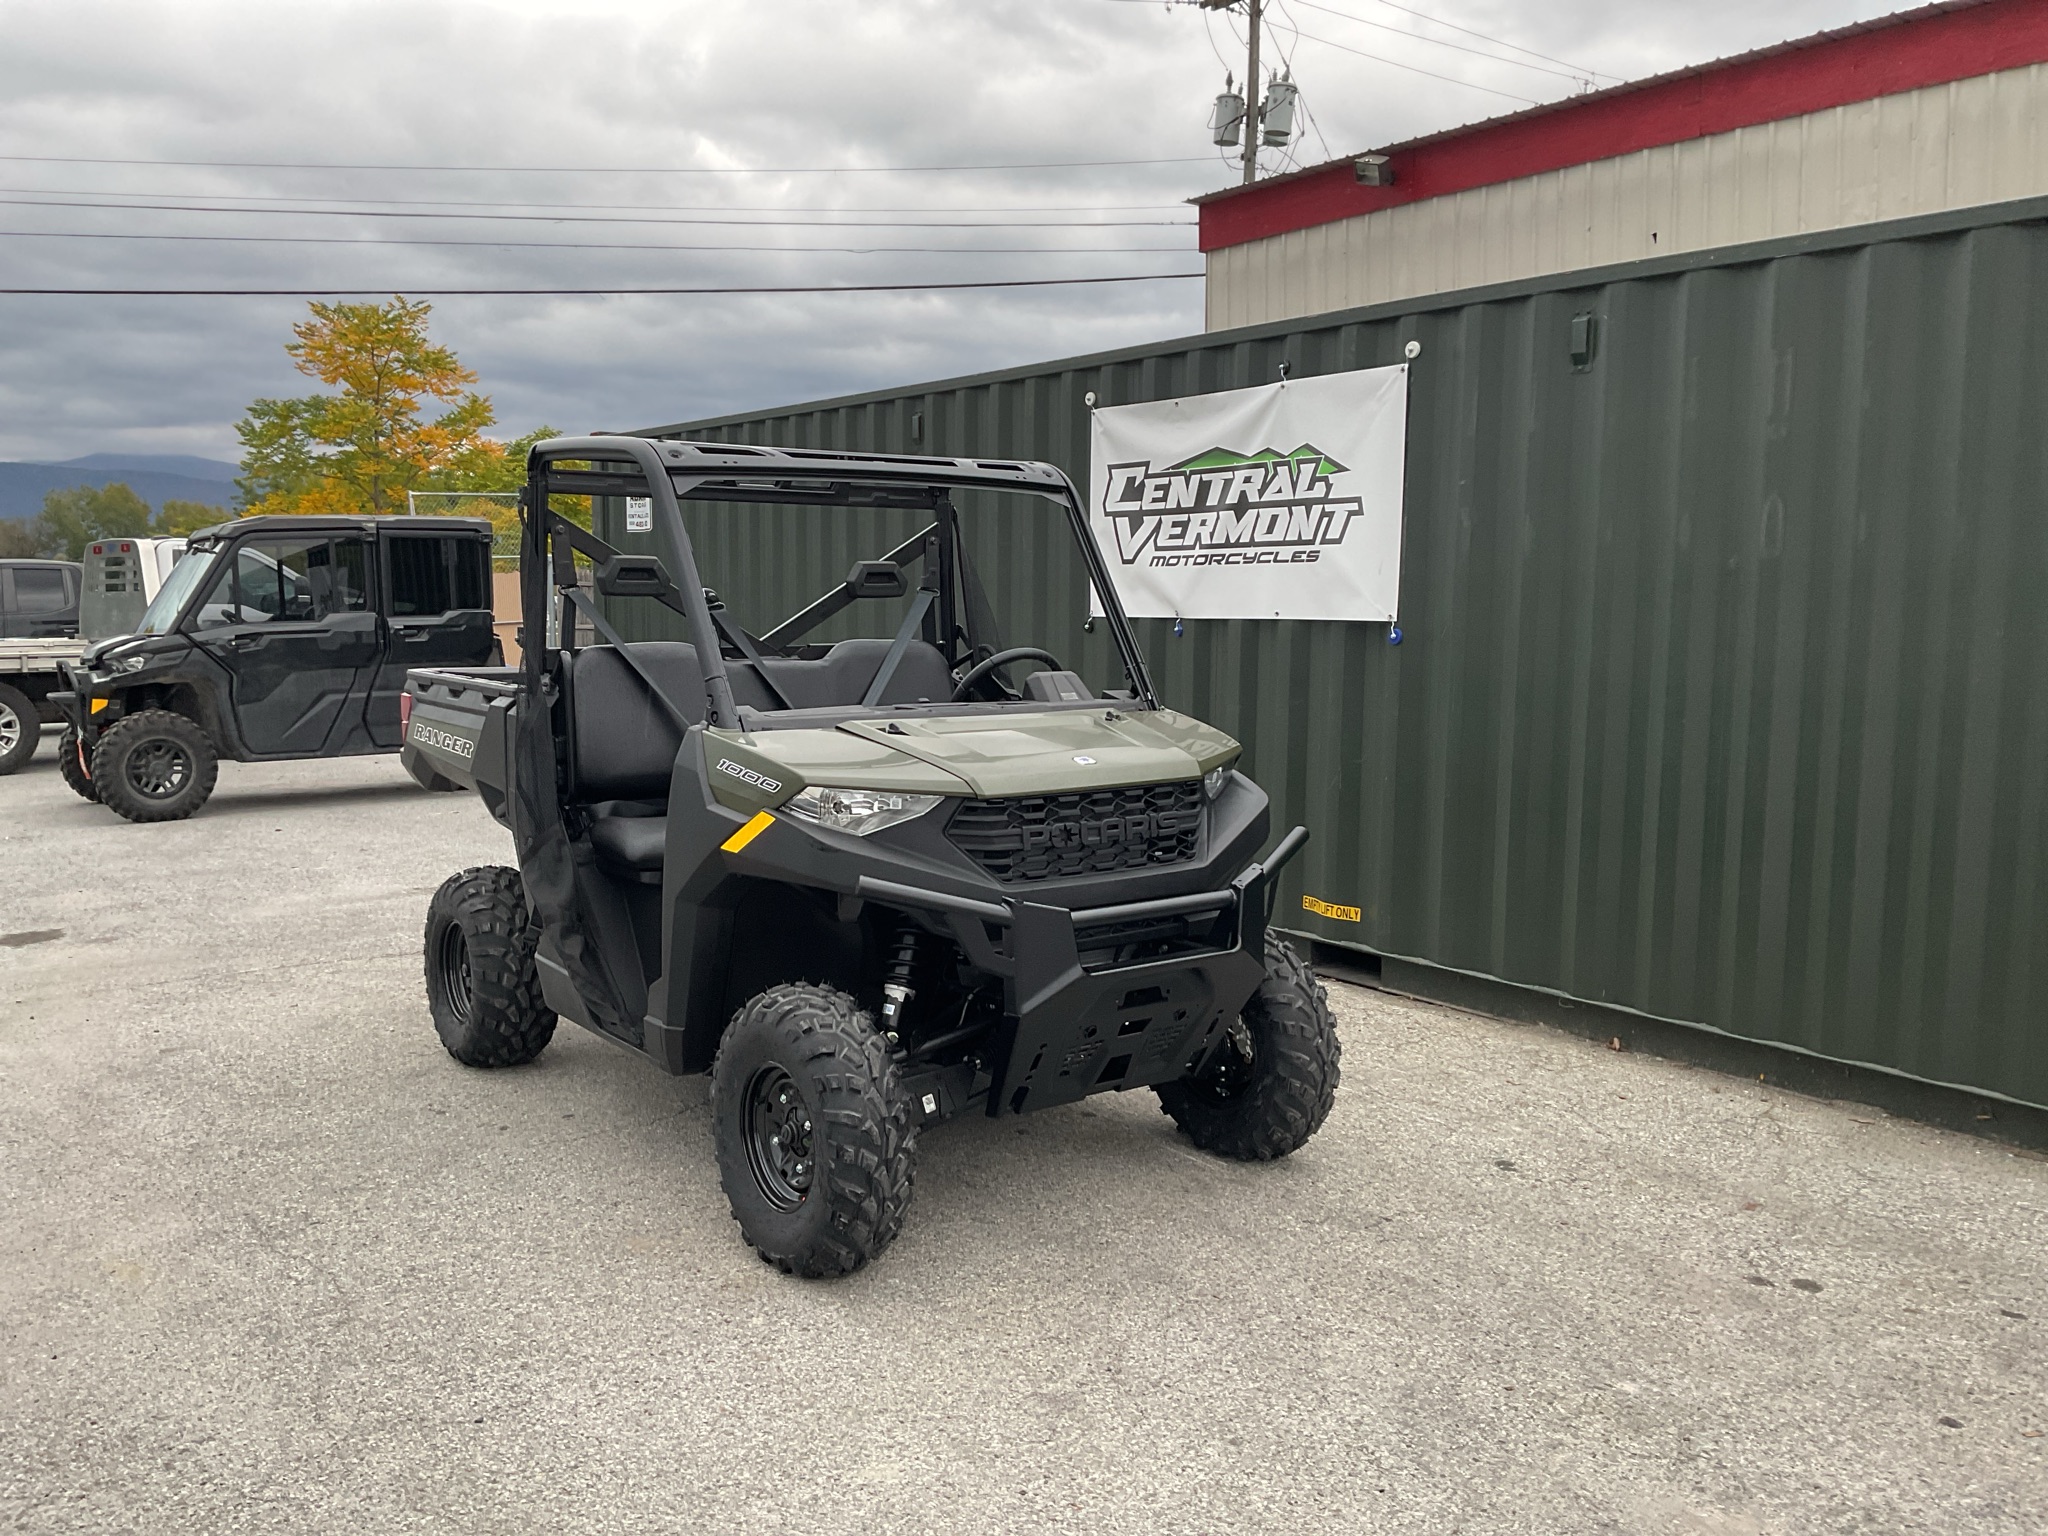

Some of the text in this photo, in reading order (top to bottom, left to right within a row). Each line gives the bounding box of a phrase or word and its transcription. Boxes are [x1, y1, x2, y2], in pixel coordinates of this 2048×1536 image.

[1104, 457, 1329, 514] CENTRAL
[1114, 498, 1363, 564] VERMONT
[1149, 550, 1321, 567] MOTORCYCLES
[413, 723, 474, 758] RANGER
[716, 758, 782, 793] 1000
[1023, 811, 1180, 851] POLARIS
[1321, 903, 1334, 916] LIFT
[1336, 907, 1359, 920] ONLY
